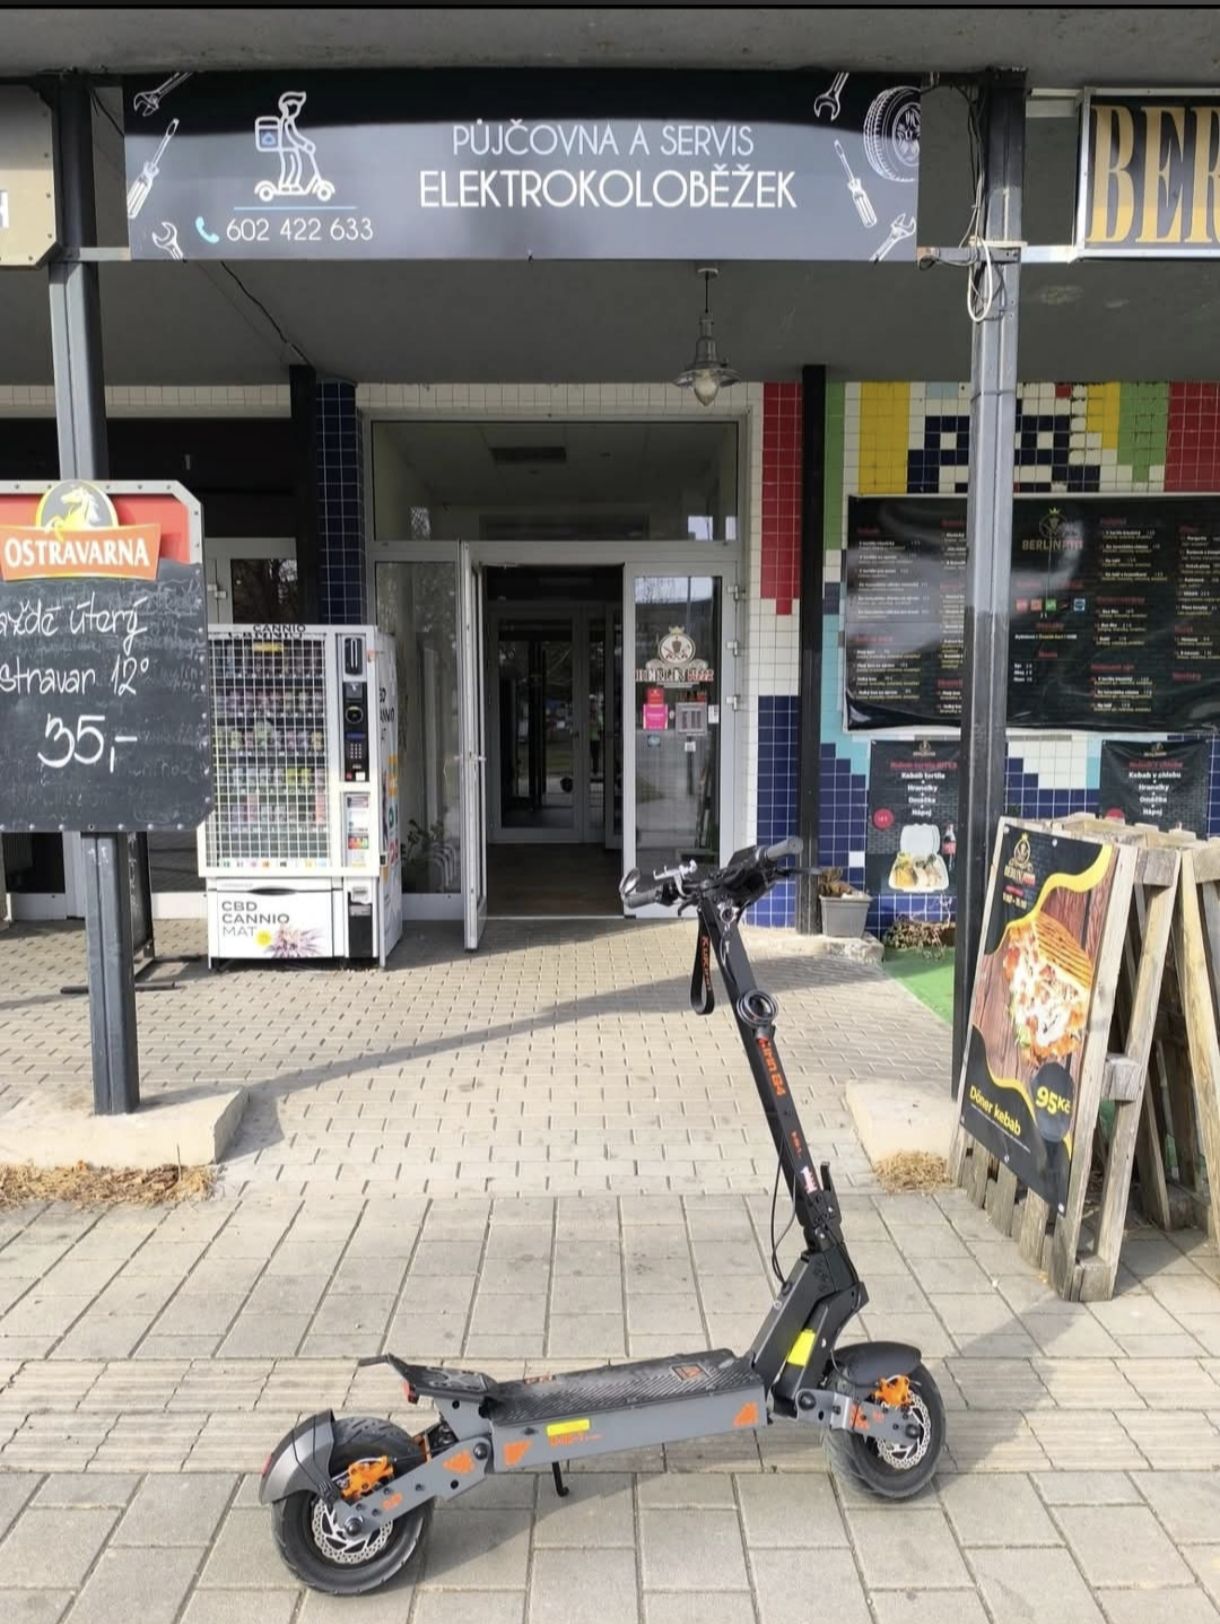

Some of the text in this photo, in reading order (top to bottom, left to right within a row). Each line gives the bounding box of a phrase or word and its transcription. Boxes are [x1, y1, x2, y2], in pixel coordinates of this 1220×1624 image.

[453, 118, 754, 156] PŮJČOVNA A SERVIS
[419, 163, 798, 208] ELEKTROKOLOBĚŽEK
[226, 217, 374, 241] 602 422 633
[4, 537, 150, 568] OSTRAVARNA
[253, 623, 306, 633] CANNIO
[221, 900, 258, 912] CBD
[221, 912, 290, 924] CANNIO
[222, 925, 257, 937] MAT
[993, 1103, 1021, 1137] kebab
